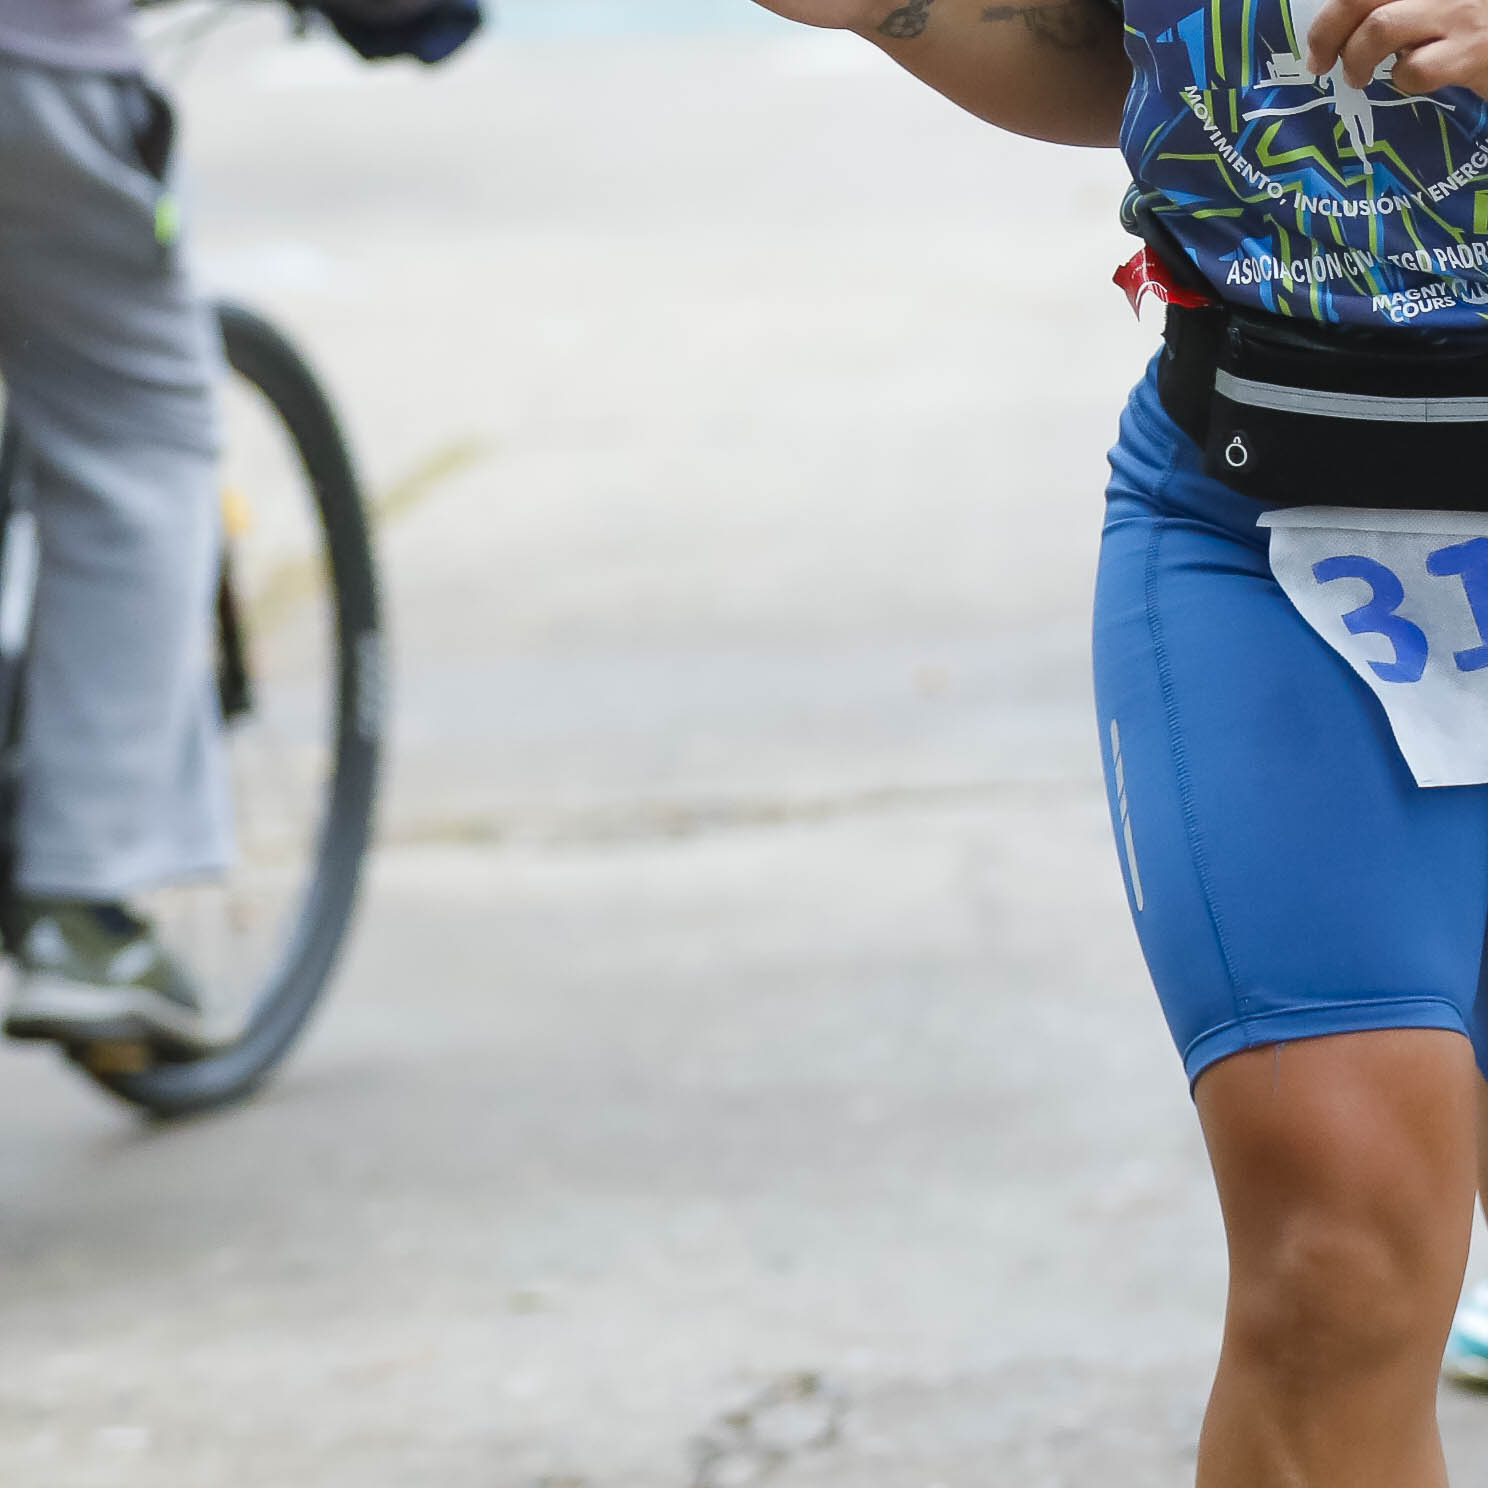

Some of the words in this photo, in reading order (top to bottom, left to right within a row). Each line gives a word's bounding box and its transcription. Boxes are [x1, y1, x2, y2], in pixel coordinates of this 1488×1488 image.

[1294, 191, 1412, 218] INCLUSIÓN
[1226, 247, 1344, 285] ASOCIACIÓN
[1372, 282, 1446, 312] MAGNY
[1390, 297, 1456, 323] COURS
